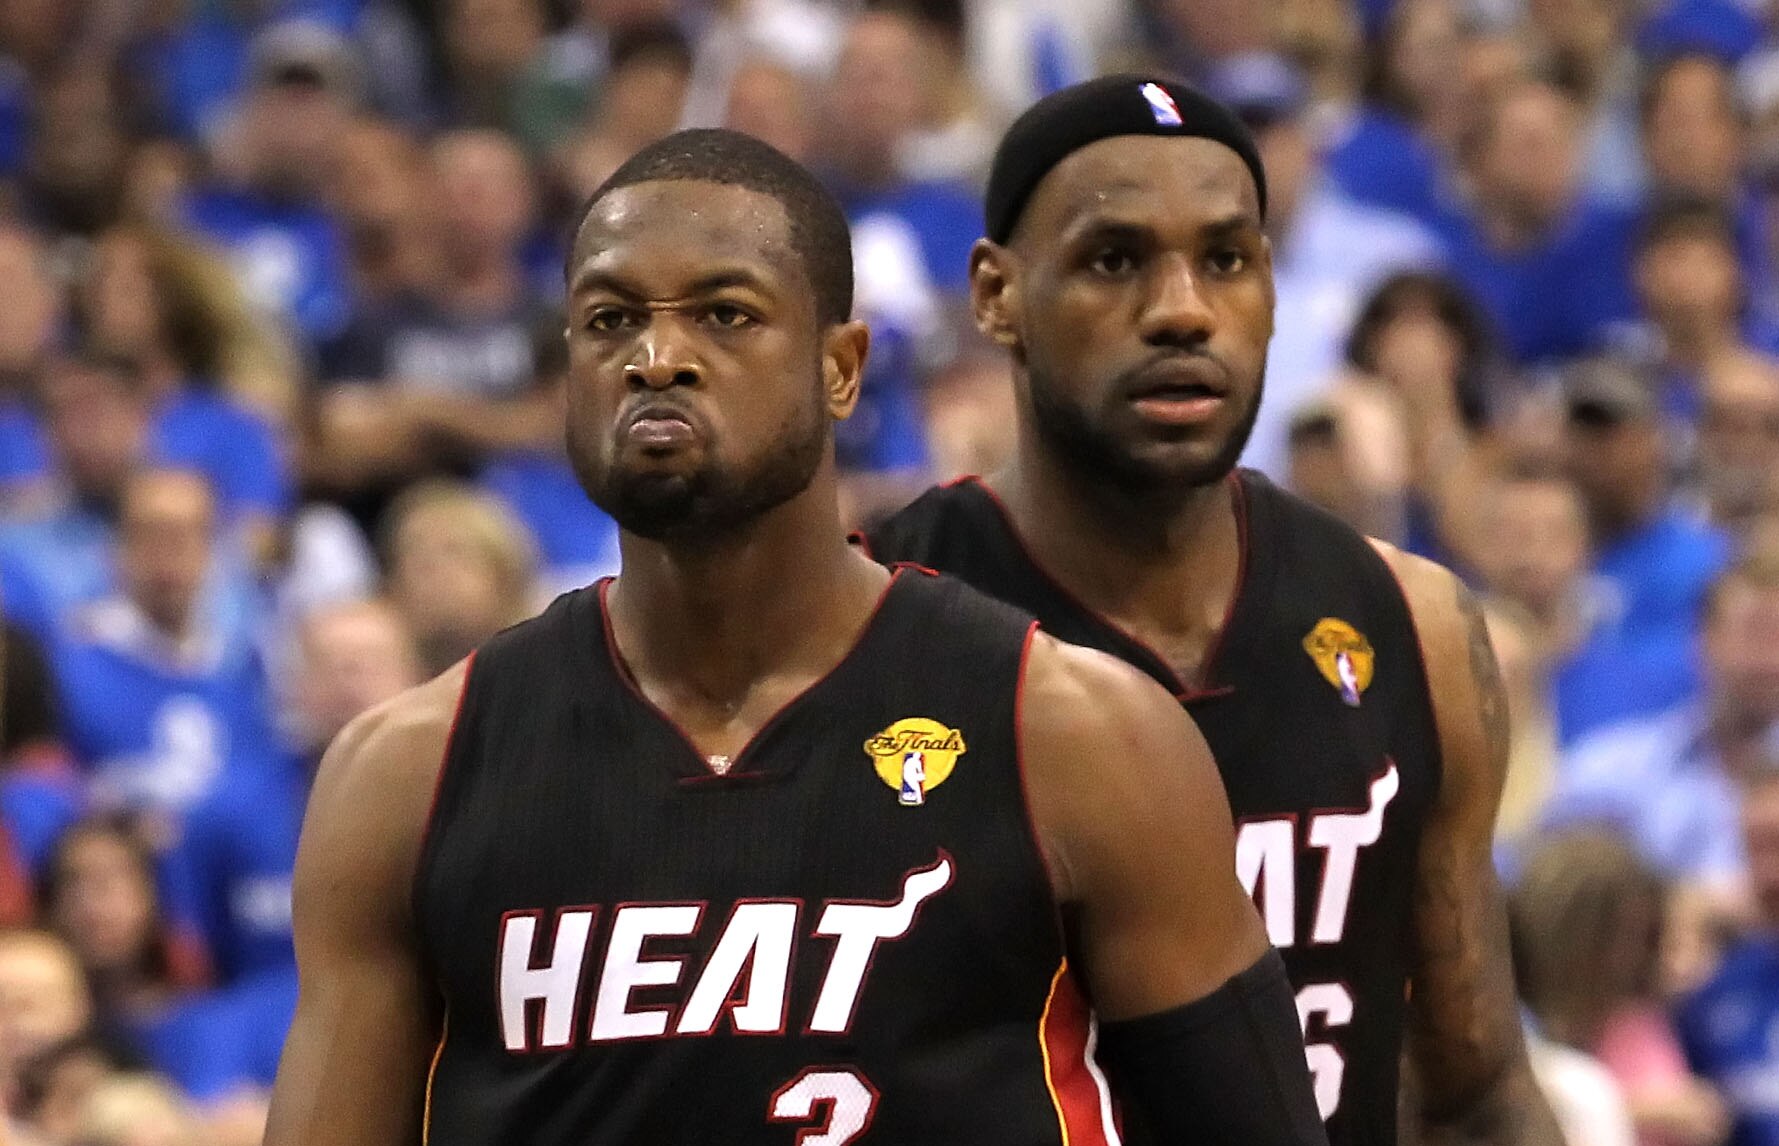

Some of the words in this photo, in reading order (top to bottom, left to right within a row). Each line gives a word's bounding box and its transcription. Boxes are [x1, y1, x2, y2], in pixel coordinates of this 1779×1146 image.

[877, 729, 961, 756] Finals
[1235, 758, 1400, 948] AT
[497, 850, 955, 1053] HEAT
